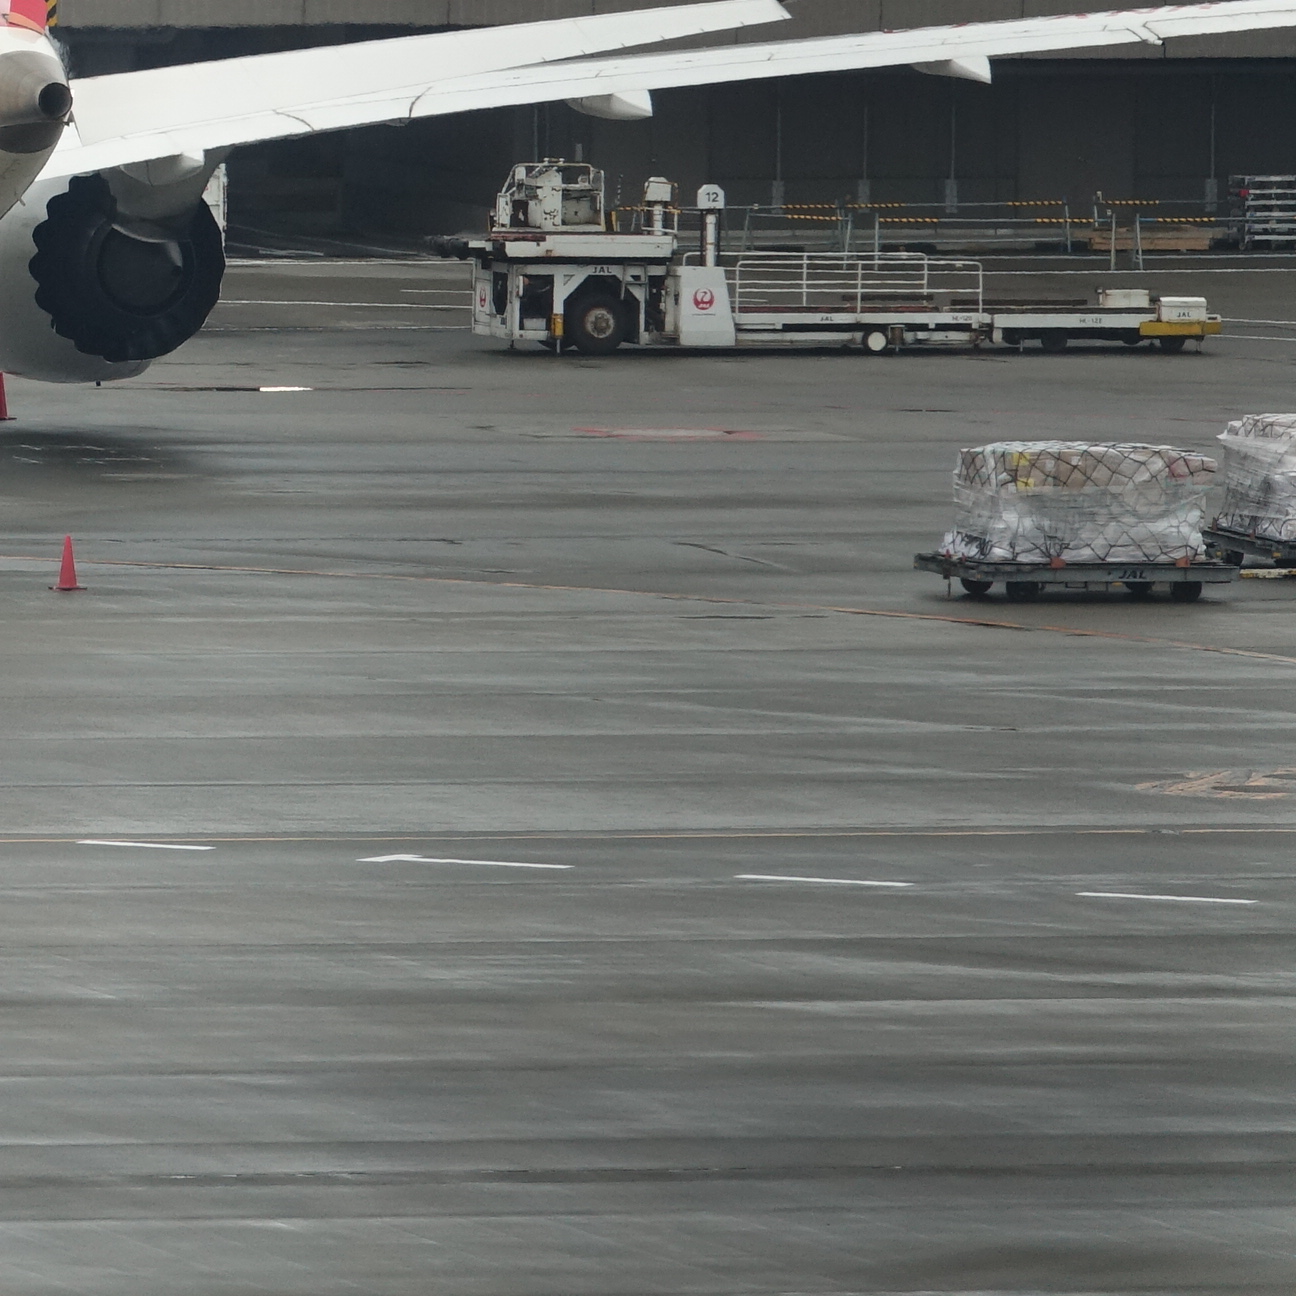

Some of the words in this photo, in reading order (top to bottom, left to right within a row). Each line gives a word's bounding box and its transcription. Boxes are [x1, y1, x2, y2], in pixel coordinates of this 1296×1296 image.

[705, 191, 719, 202] 12
[591, 266, 612, 274] JAL
[1118, 570, 1146, 580] JAL
